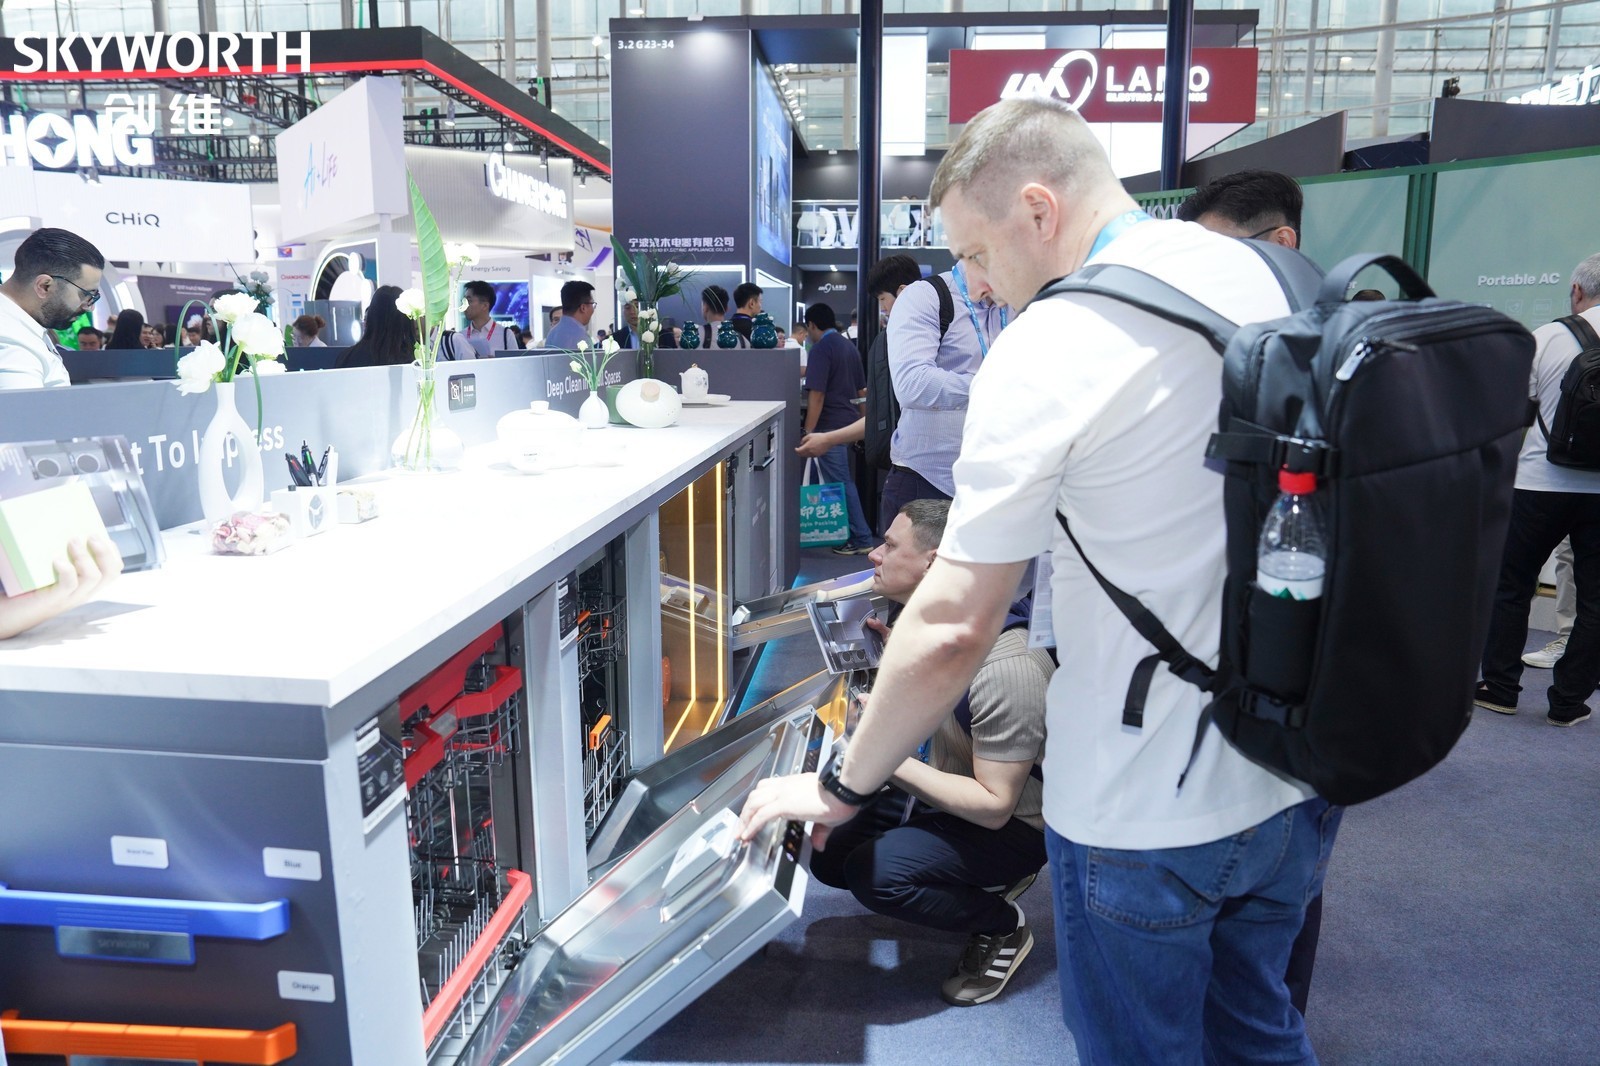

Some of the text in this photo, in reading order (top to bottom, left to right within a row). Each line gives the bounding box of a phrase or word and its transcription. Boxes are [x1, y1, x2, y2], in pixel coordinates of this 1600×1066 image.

[13, 30, 311, 74] SKYWORTH
[471, 265, 511, 273] Energy Saving
[1477, 272, 1560, 286] Portable AC
[546, 380, 564, 400] Deep
[565, 375, 583, 394] Clean
[604, 369, 621, 386] Spaces
[148, 434, 186, 472] To
[284, 859, 302, 869] Blue
[292, 980, 320, 992] Orange
